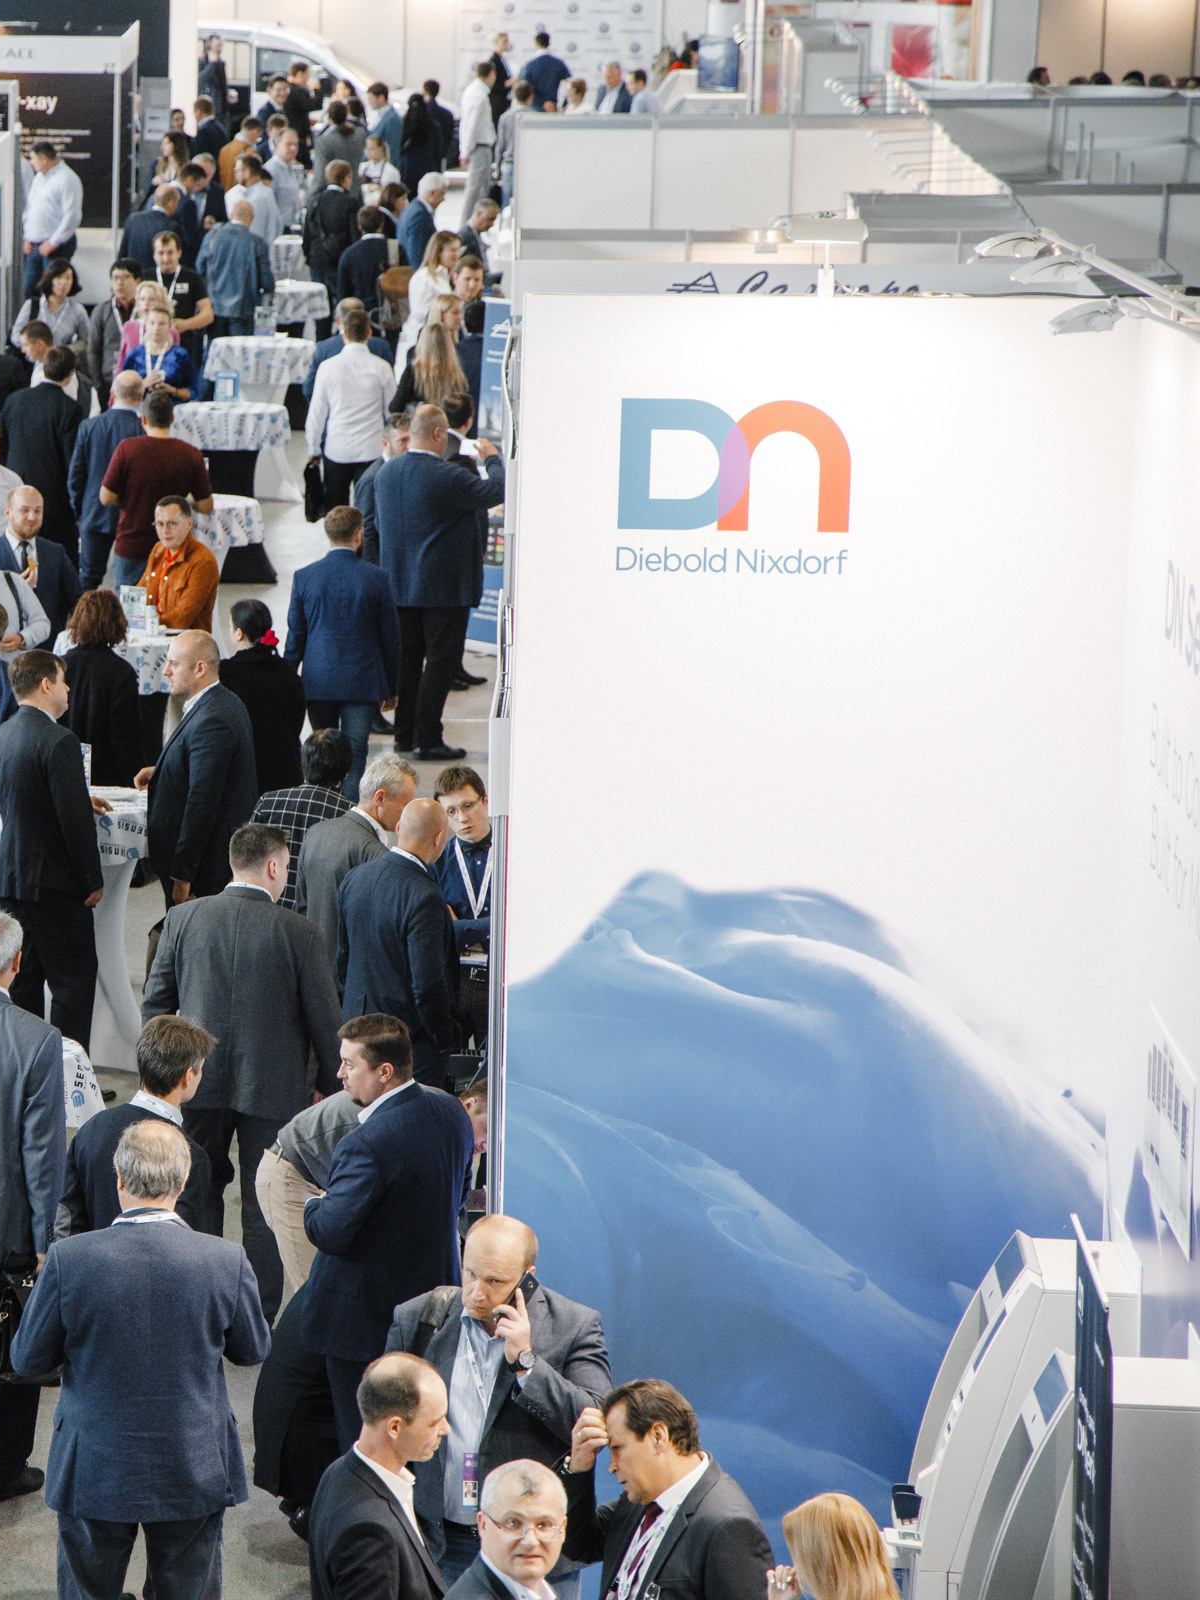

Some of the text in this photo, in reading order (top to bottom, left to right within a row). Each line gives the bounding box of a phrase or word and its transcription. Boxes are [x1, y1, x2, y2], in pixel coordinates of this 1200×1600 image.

[17, 96, 58, 115] -хау
[616, 546, 848, 575] Diebold Nixdorf
[1165, 559, 1185, 656] DN
